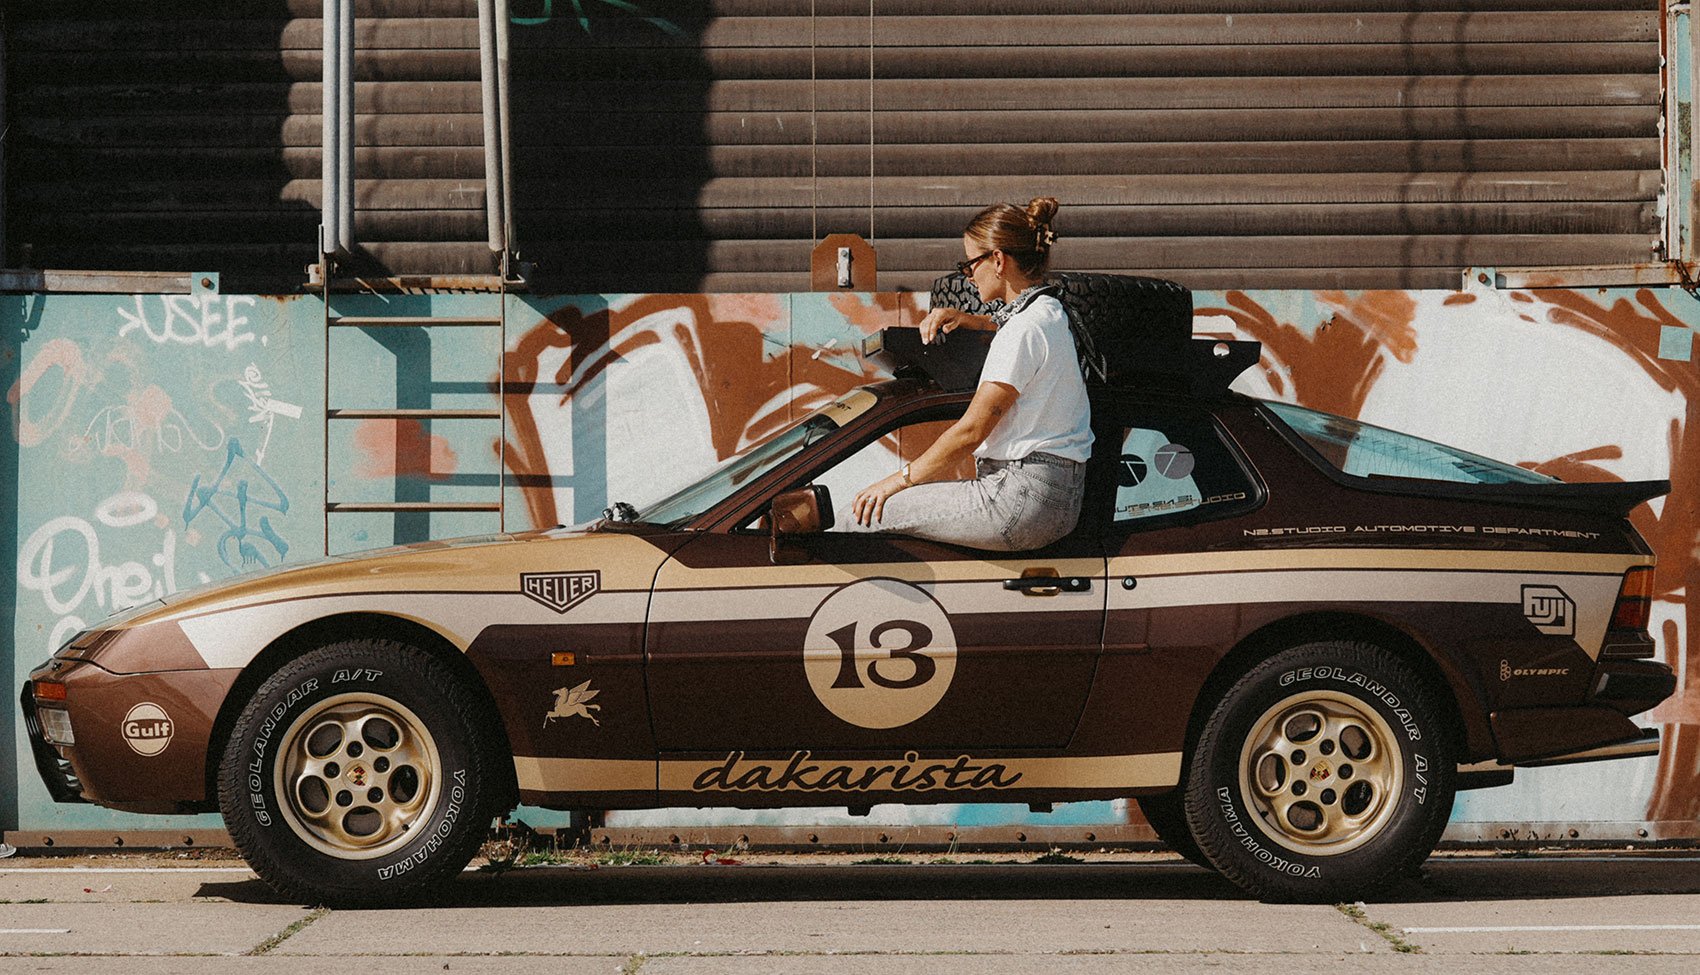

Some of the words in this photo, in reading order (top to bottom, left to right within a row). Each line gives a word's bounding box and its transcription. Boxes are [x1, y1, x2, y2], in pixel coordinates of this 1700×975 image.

[1353, 525, 1476, 533] AUTOMOTIVE
[1482, 526, 1601, 540] DEPARTMENT
[528, 576, 593, 606] HEUER
[825, 619, 937, 689] 13
[1513, 668, 1570, 676] OLYMPIC
[125, 722, 170, 737] Gulf
[248, 678, 319, 827] GEOLANDAR
[331, 668, 383, 683] A/T
[1279, 666, 1422, 742] GEOLANDAR
[1413, 753, 1429, 805] A/T
[693, 750, 1023, 793] dakarista
[377, 769, 466, 880] YOKOHAMA
[1216, 786, 1323, 880] YOKOHAMA
